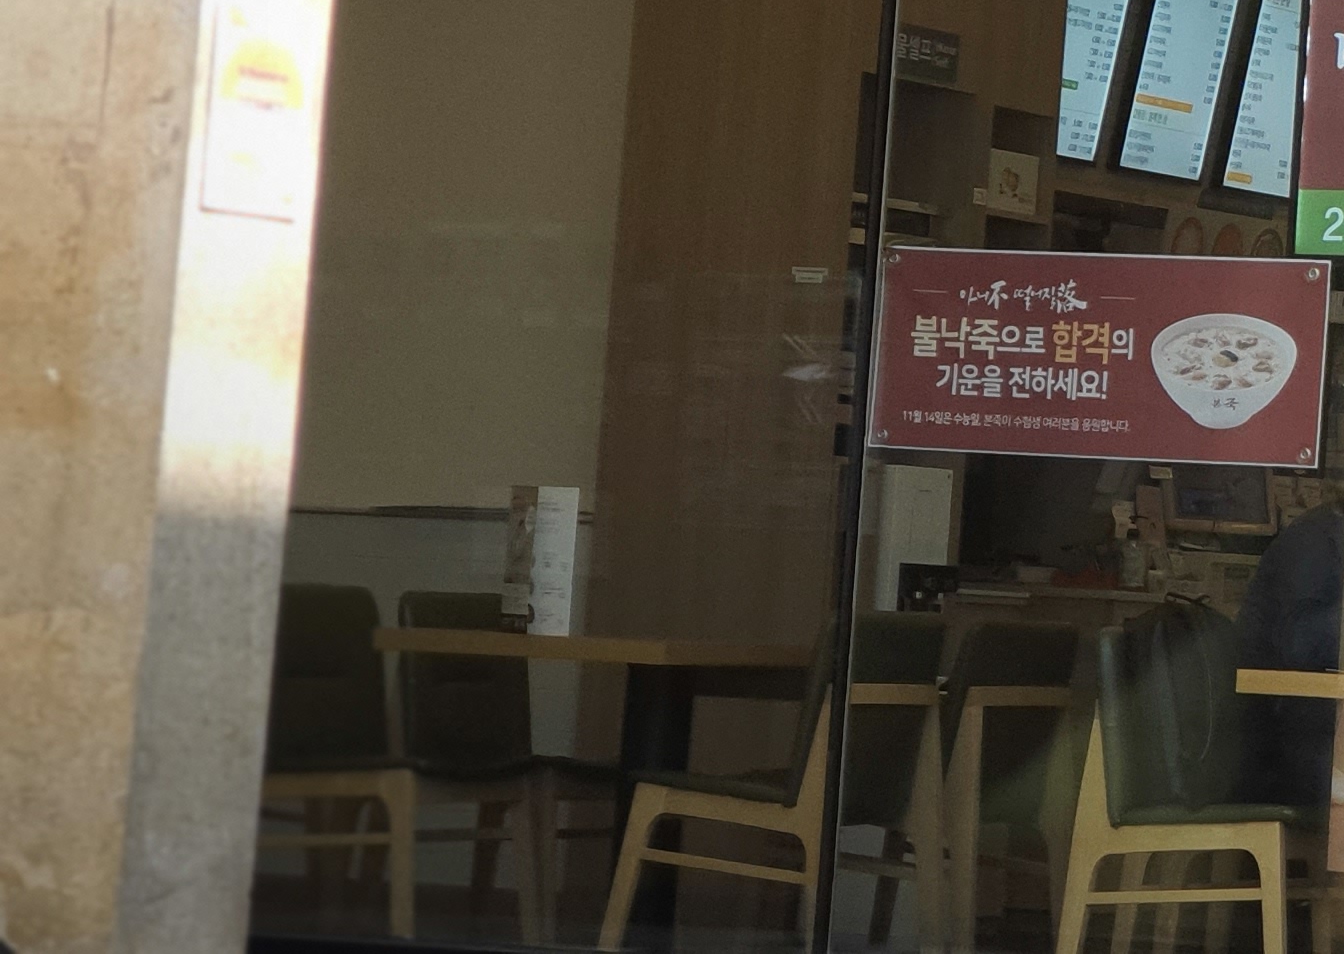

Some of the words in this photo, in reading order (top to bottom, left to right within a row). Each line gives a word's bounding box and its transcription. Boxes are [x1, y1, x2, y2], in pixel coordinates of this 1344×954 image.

[910, 314, 1046, 360] 불낙죽으로
[1051, 320, 1135, 365] 합격의
[935, 362, 1004, 396] 기운을
[1008, 365, 1109, 401] 전하세요!
